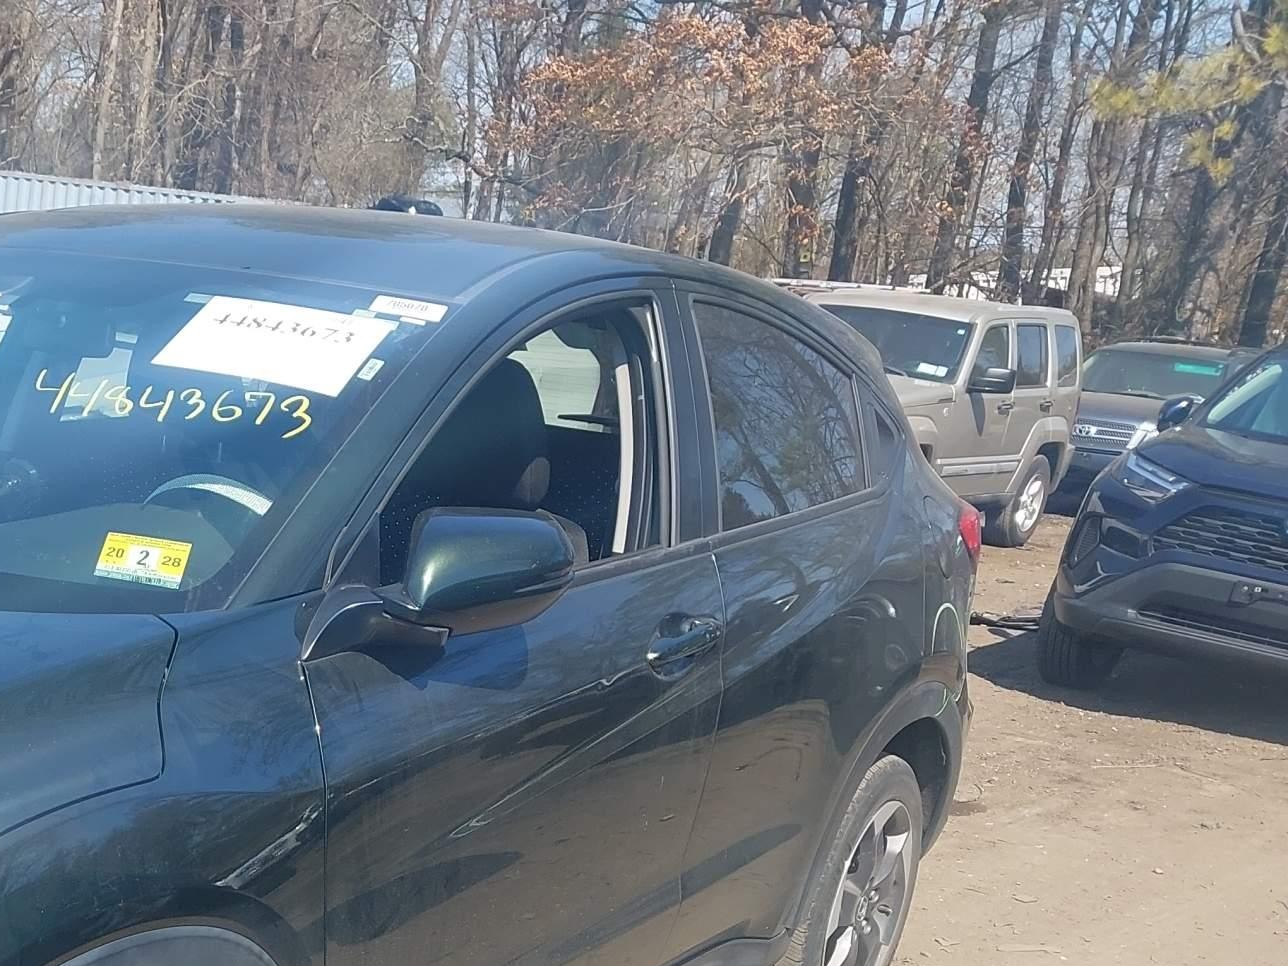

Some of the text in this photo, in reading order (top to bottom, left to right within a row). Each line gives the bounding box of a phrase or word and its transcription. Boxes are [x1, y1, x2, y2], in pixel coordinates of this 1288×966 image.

[212, 312, 356, 344] 44843673
[34, 367, 313, 440] 44843673
[106, 546, 182, 568] 20 2 28
